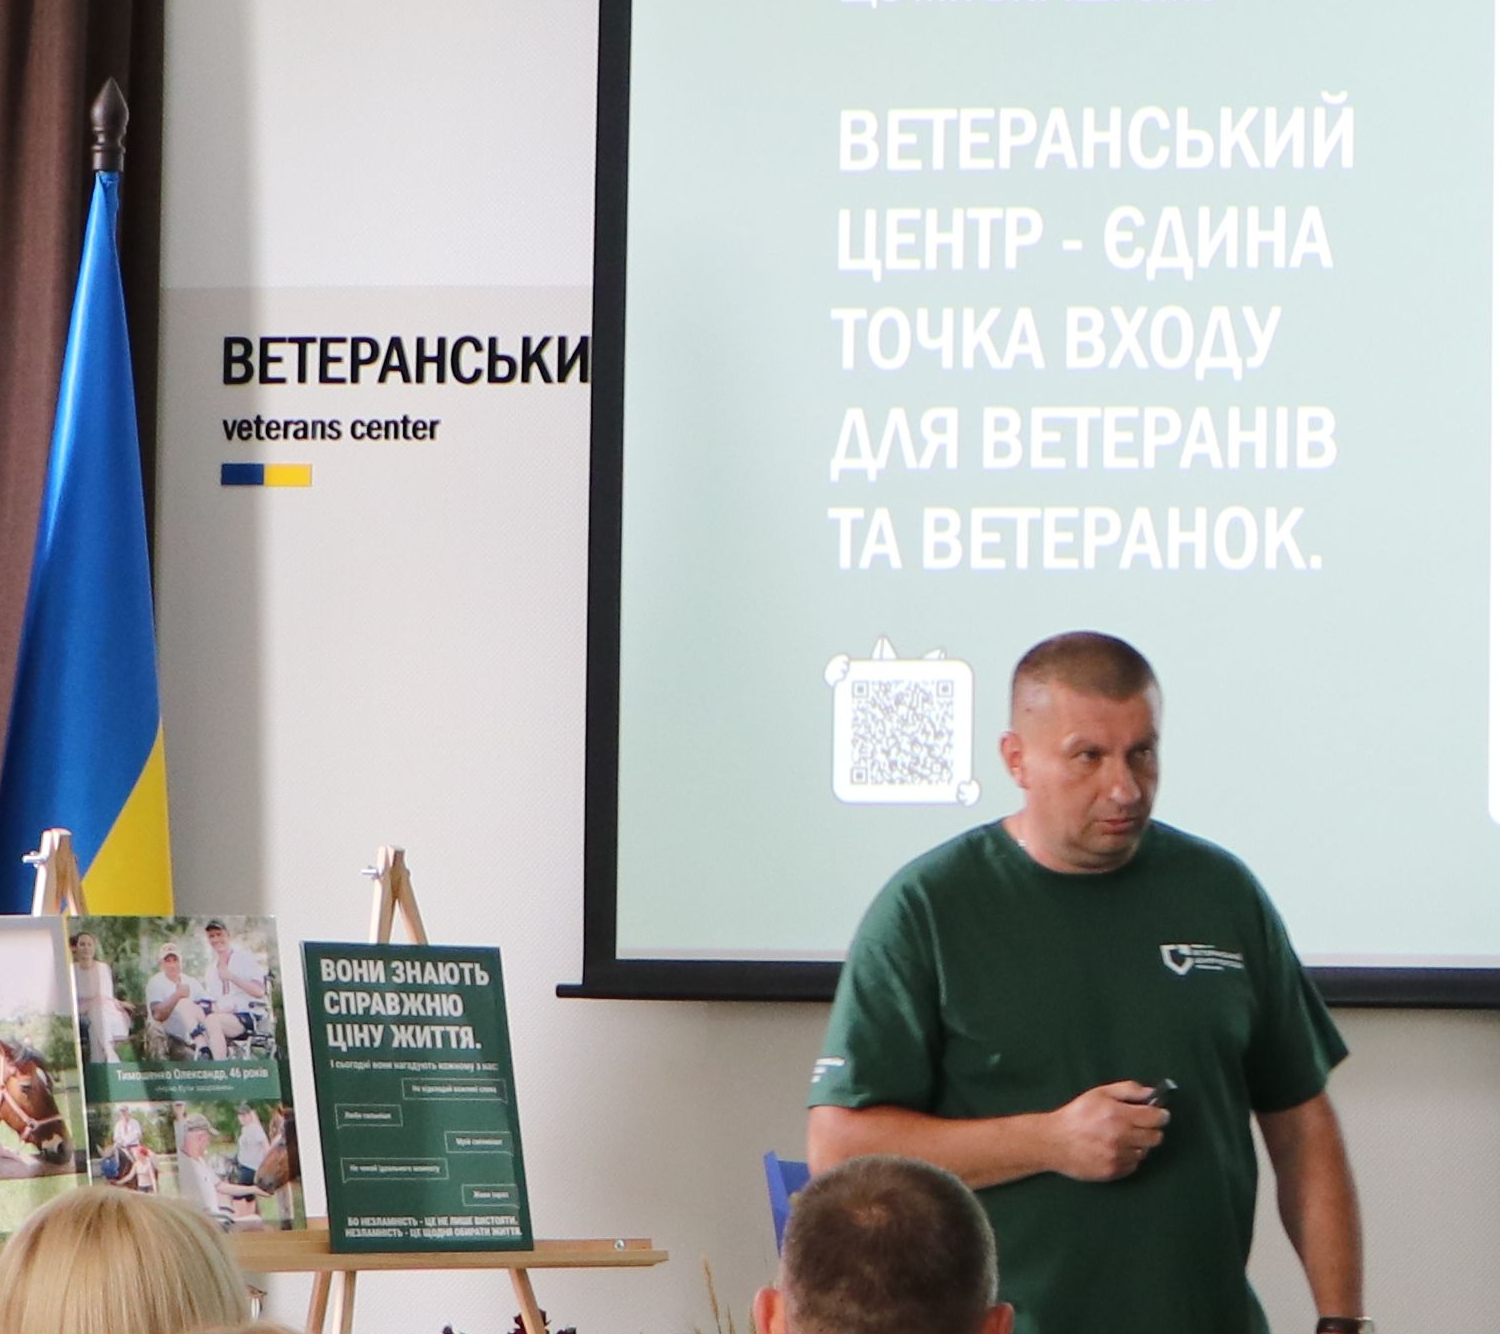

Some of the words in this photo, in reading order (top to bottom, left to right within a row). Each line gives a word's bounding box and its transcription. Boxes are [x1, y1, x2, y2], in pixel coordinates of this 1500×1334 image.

[838, 91, 1357, 173] ВЕТЕРАНСЬКИЙ
[835, 207, 1043, 282] ЦЕНТР
[1103, 204, 1333, 281] ЄДИНА
[830, 308, 1045, 372] ТОЧКА
[1064, 305, 1282, 381] ВХОДУ
[222, 414, 343, 441] veterans
[349, 414, 440, 441] center
[829, 408, 959, 482] ДЛЯ
[980, 406, 1338, 472] ВЕТЕРАНІВ
[828, 509, 903, 572] ТА
[921, 506, 1324, 573] ВЕТЕРАНОК.
[319, 957, 386, 984] ВОНИ
[390, 960, 490, 986] ЗНАЮТЬ
[323, 990, 464, 1017] СПРАВЖНЮ
[326, 1023, 384, 1052] ЦІНУ
[390, 1024, 483, 1050] ЖИТТЯ.
[116, 1070, 172, 1081] Тимошенко
[229, 1067, 241, 1078] 46
[242, 1066, 268, 1080] років
